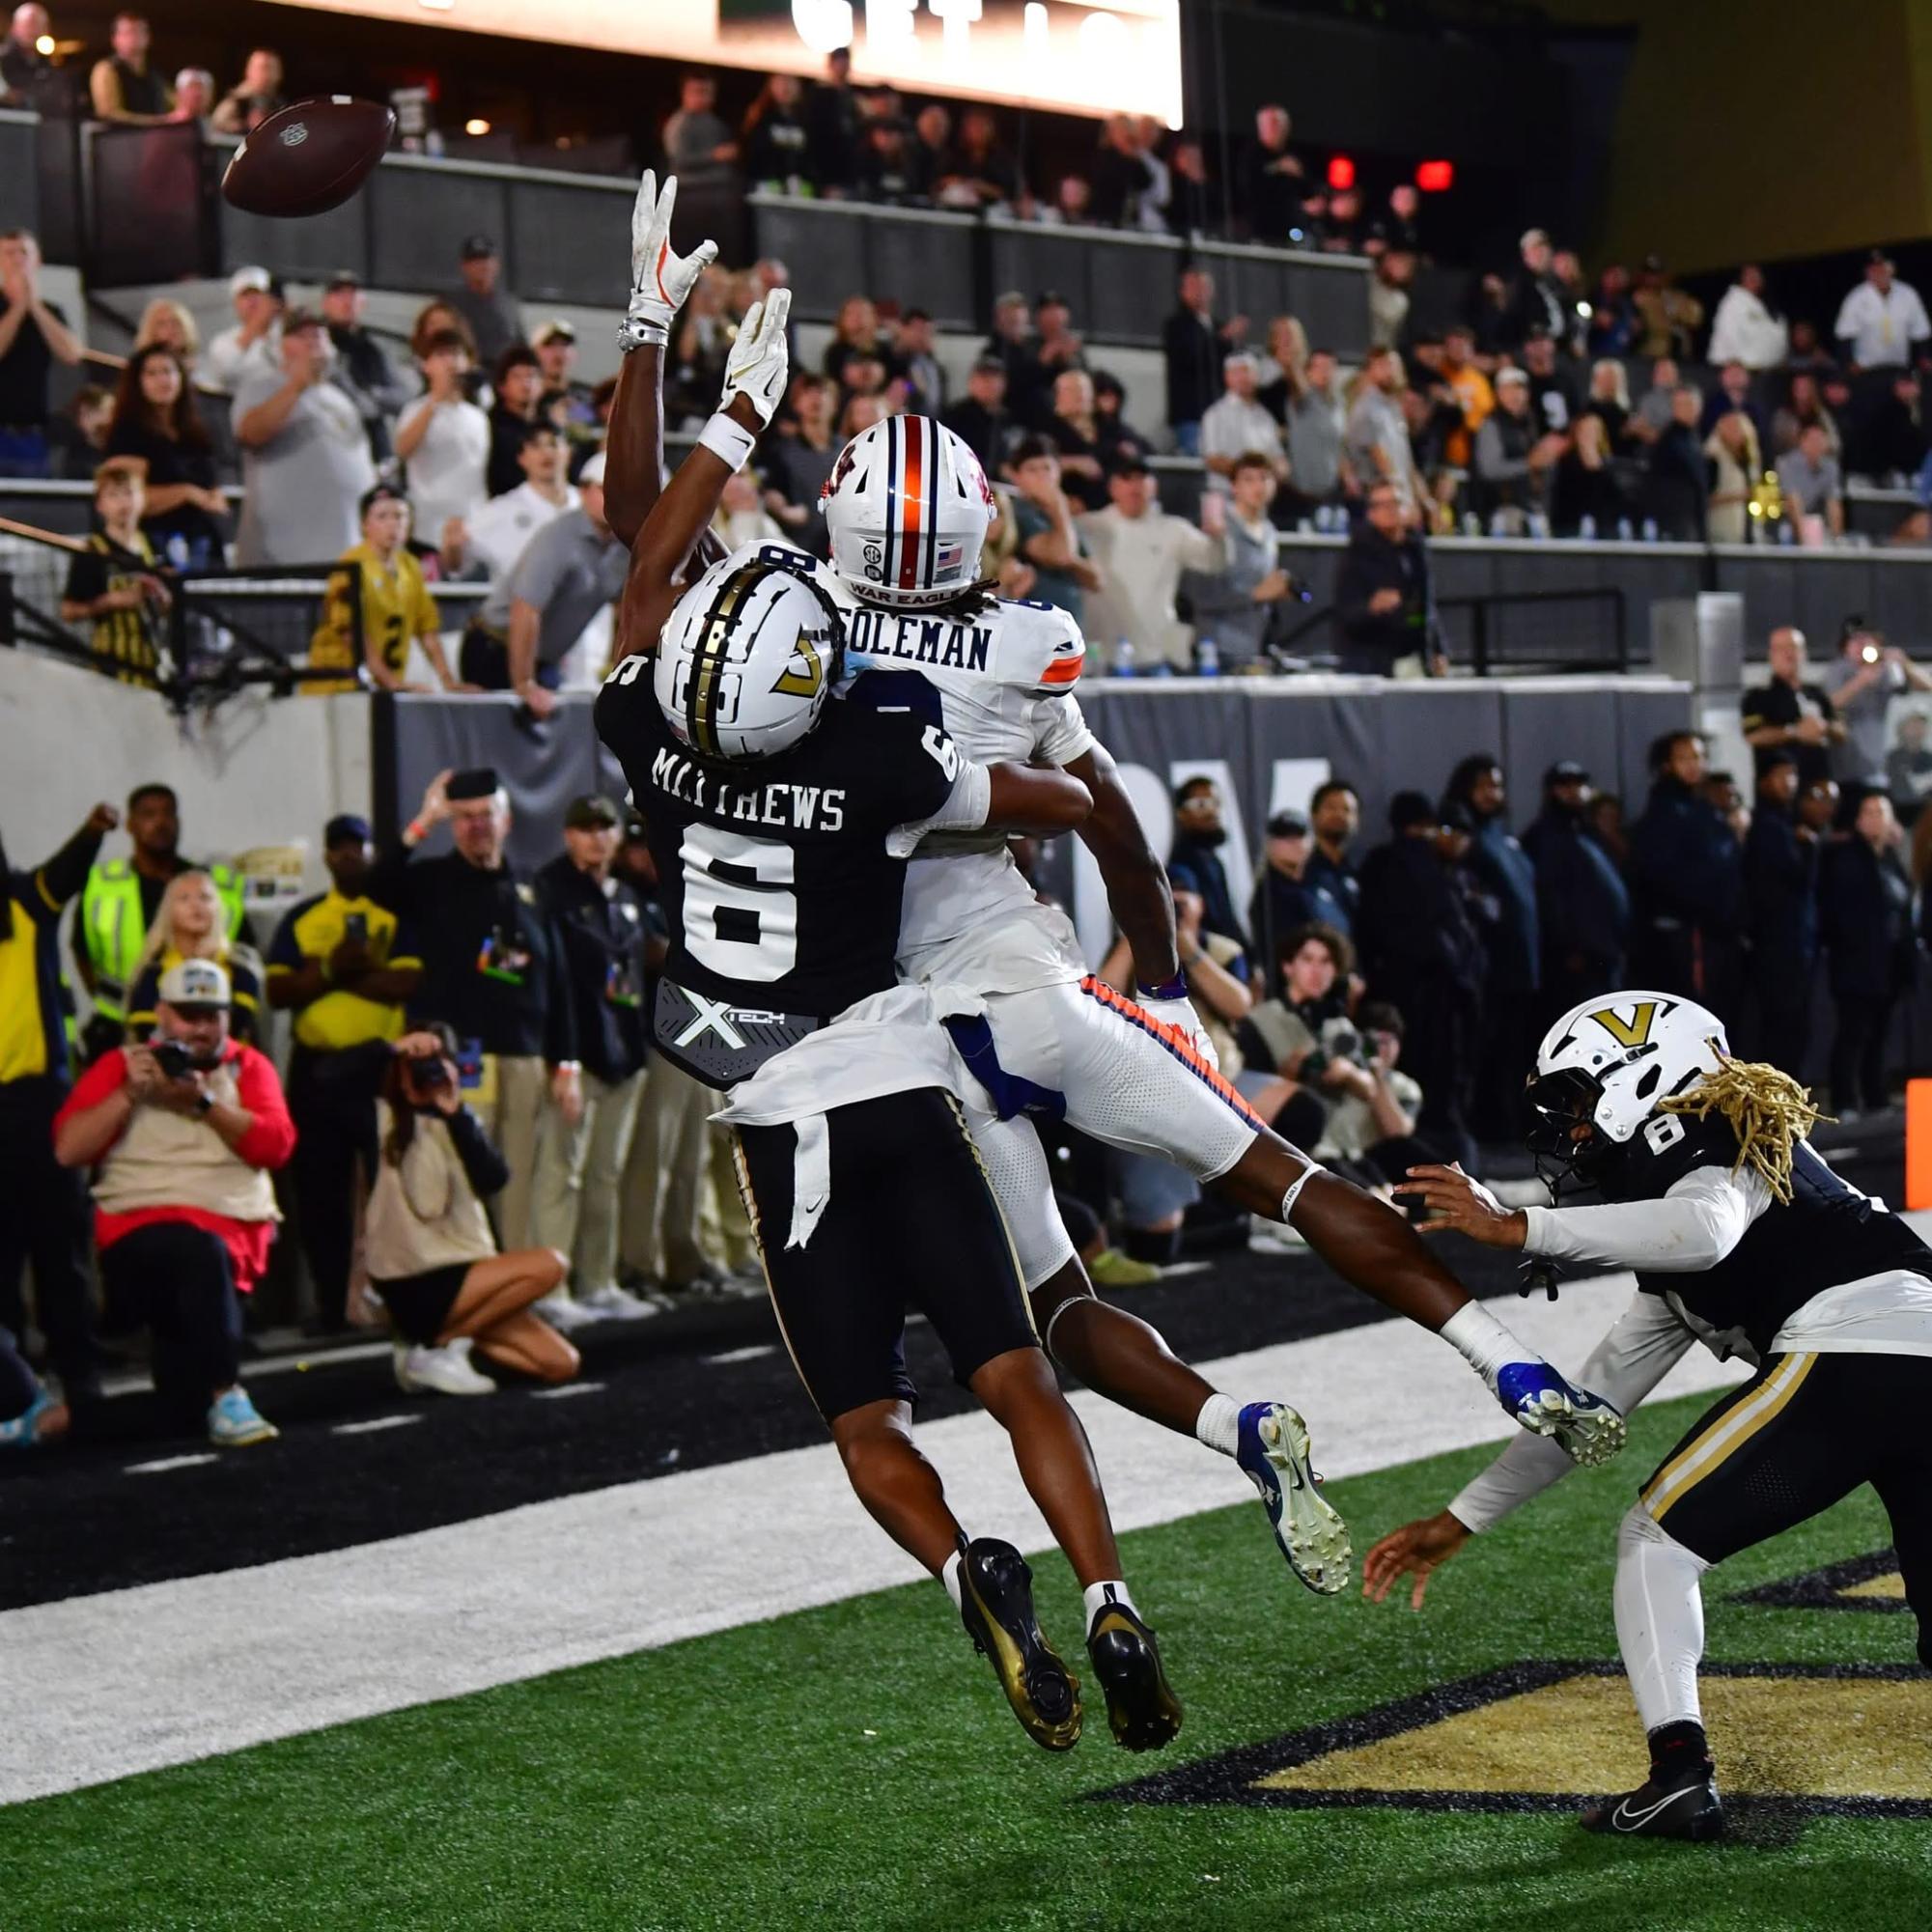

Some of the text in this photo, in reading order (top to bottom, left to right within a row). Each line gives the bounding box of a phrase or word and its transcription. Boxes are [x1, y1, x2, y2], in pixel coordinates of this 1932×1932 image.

[851, 582, 962, 604] WAR EAGLE
[921, 725, 956, 782] 6
[678, 822, 798, 983] 6
